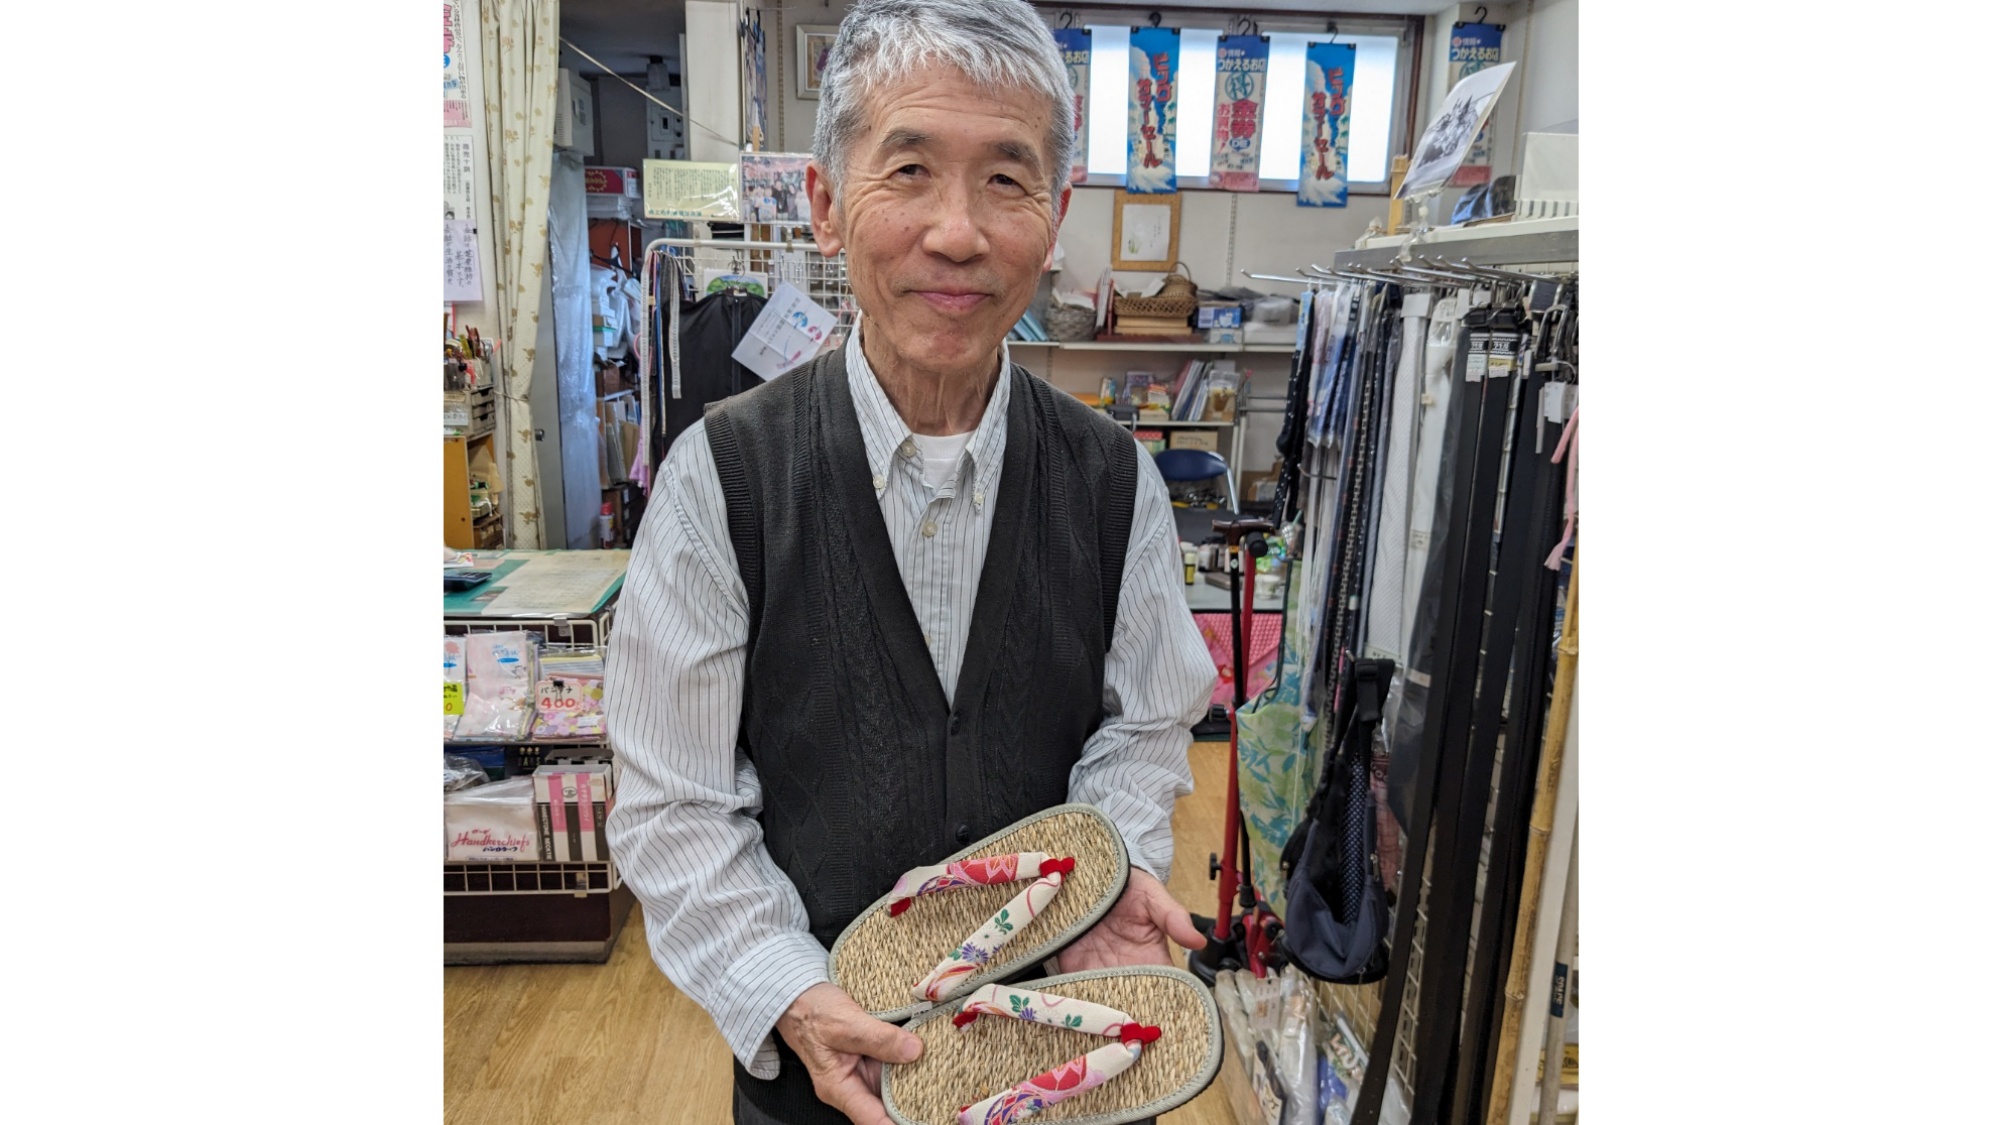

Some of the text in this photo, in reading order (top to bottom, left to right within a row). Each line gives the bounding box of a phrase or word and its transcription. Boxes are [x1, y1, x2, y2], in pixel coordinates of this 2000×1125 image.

[1452, 47, 1499, 61] つかえるお店
[1218, 58, 1266, 71] つかえるお店
[1137, 78, 1162, 168] サマーセール
[1231, 99, 1258, 138] 金券
[1232, 140, 1248, 149] DE
[1312, 92, 1334, 180] サマーセール
[541, 686, 573, 694] バンナ
[451, 832, 530, 852] Handkerchiefs
